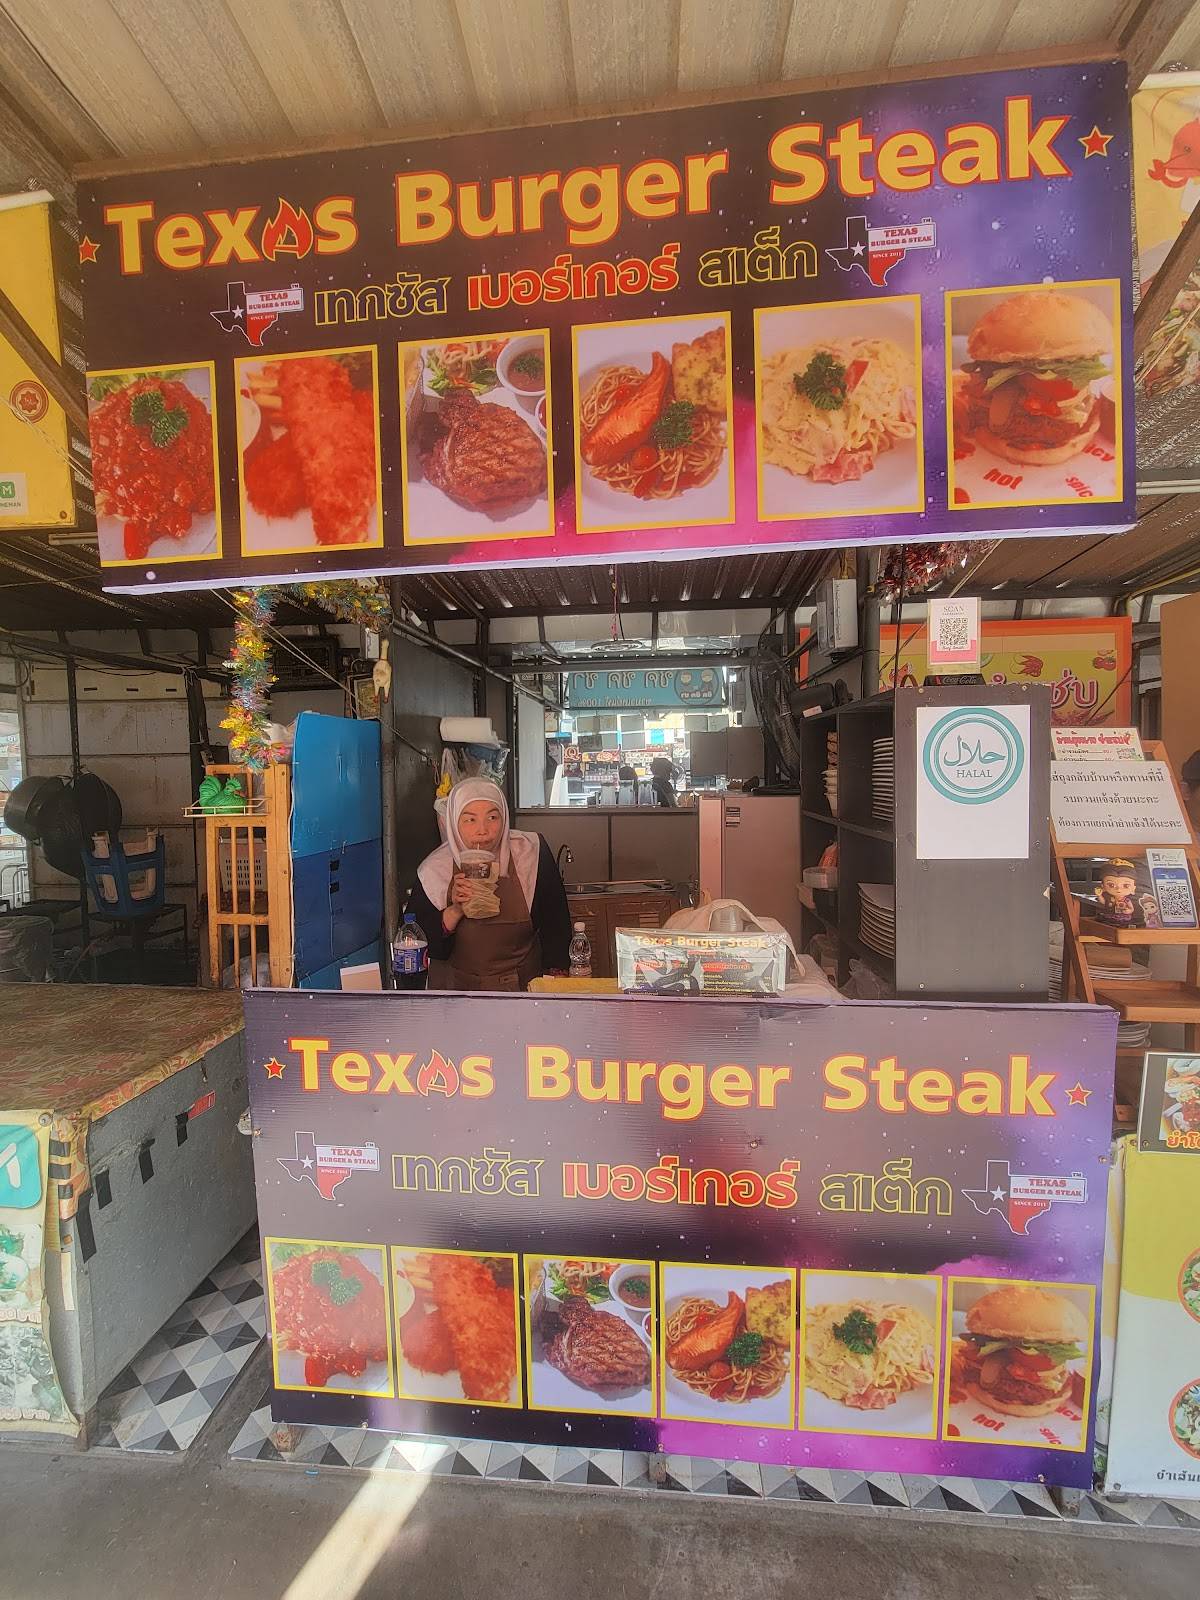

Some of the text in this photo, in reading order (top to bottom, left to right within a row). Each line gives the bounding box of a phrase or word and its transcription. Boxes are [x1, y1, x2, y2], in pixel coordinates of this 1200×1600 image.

[103, 96, 1072, 276] Texas Burger Steak
[884, 227, 918, 238] TEXAS
[871, 239, 900, 247] BURGER
[315, 226, 818, 326] เทกซัส เบอร์เกอร์ สเต็ก
[260, 292, 288, 301] TEXAS
[249, 302, 273, 310] BURGER
[983, 468, 1023, 490] hot
[944, 735, 1006, 767] حلال
[957, 769, 993, 778] HALAL
[677, 936, 721, 948] Burger
[727, 937, 768, 948] Steak
[288, 1036, 1058, 1122] Texas Burger Steak
[331, 1148, 363, 1157] TEXAS
[391, 1147, 953, 1216] เทกซัส เบอร์เกอร์ สเต็ก
[1028, 1178, 1067, 1187] TEXAS
[1012, 1187, 1046, 1195] BURGER
[1055, 1188, 1082, 1197] STEAK
